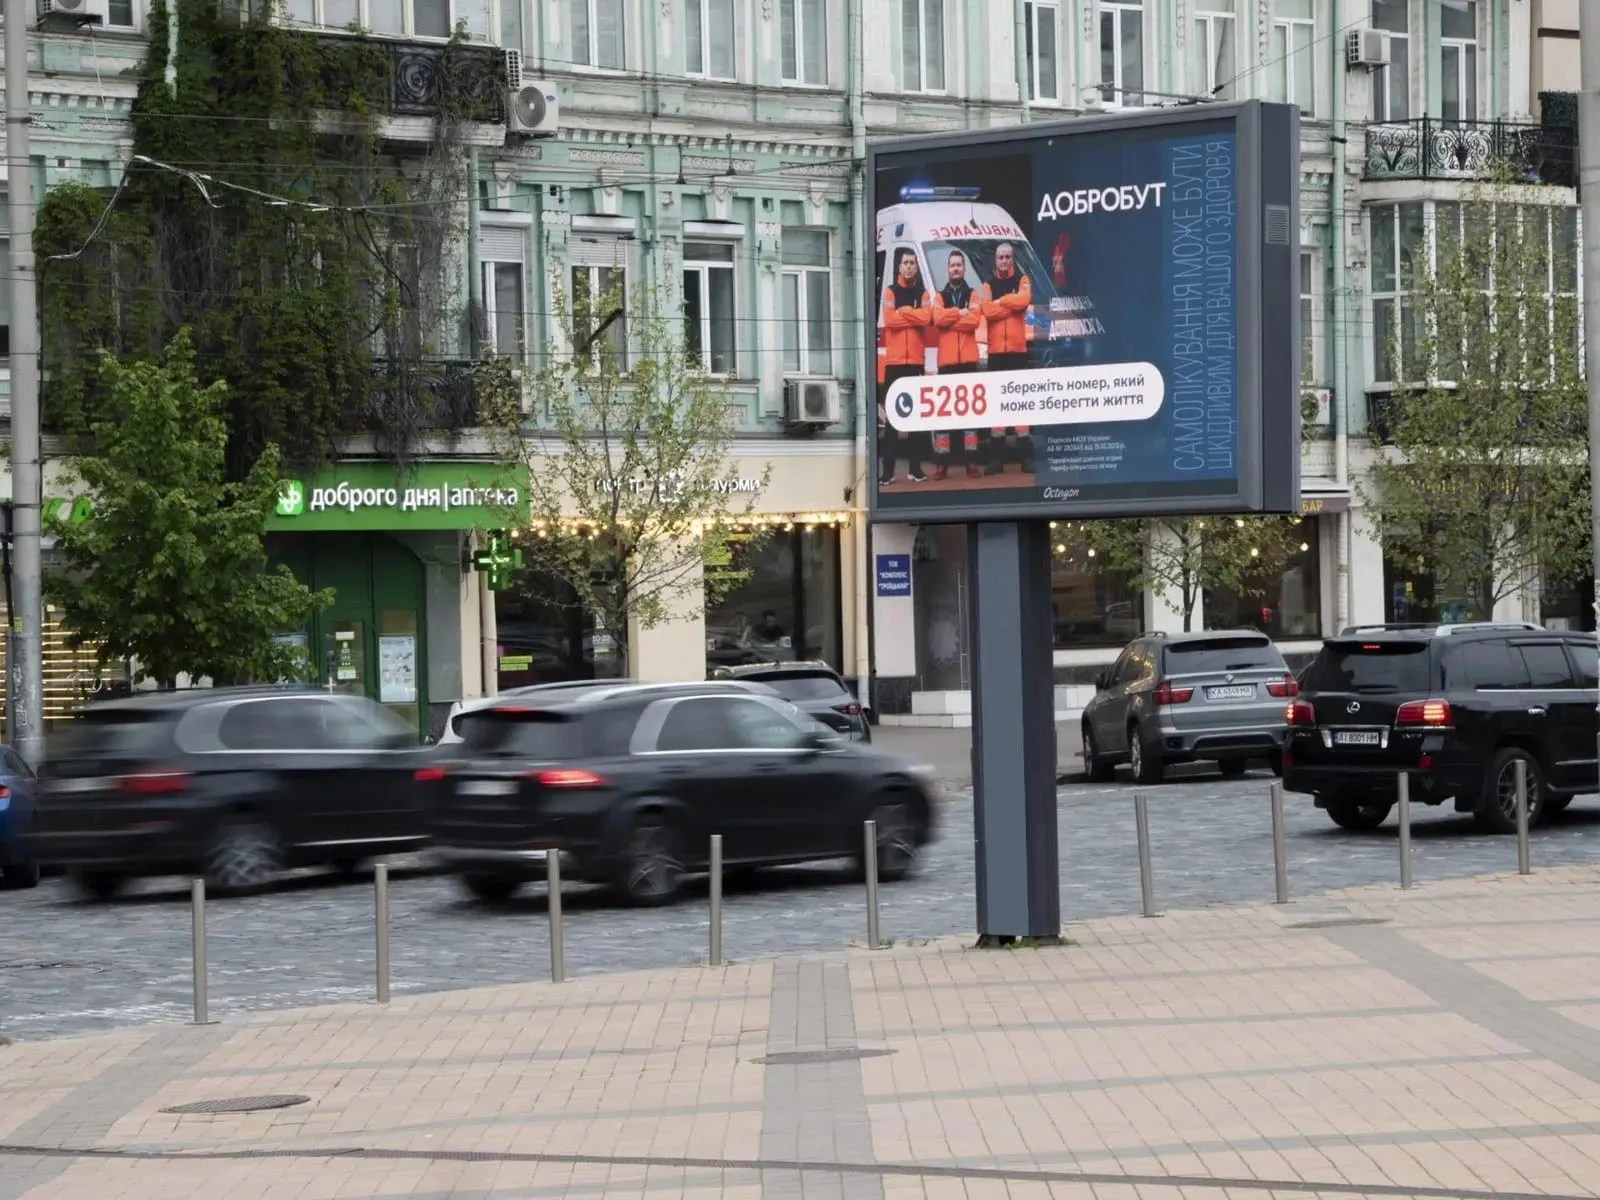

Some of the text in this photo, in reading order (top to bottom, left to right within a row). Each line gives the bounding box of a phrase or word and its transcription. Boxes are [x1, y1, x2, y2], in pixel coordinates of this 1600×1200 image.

[1037, 182, 1167, 221] ДОБРОБУТ
[1206, 232, 1232, 308] ВАШОГО
[1172, 143, 1204, 470] САМОЛІКУВАННЯ МОЖЕ БУТИ
[1206, 313, 1236, 350] ДЛЯ
[919, 383, 987, 418] 5288
[1000, 374, 1145, 396] збережіть номер, який
[1000, 394, 1144, 412] може зберегти життя
[1207, 355, 1237, 469] ШКІДЛИВИМ
[311, 481, 397, 512] доброго
[402, 488, 441, 511] дня
[697, 479, 760, 494] аурми
